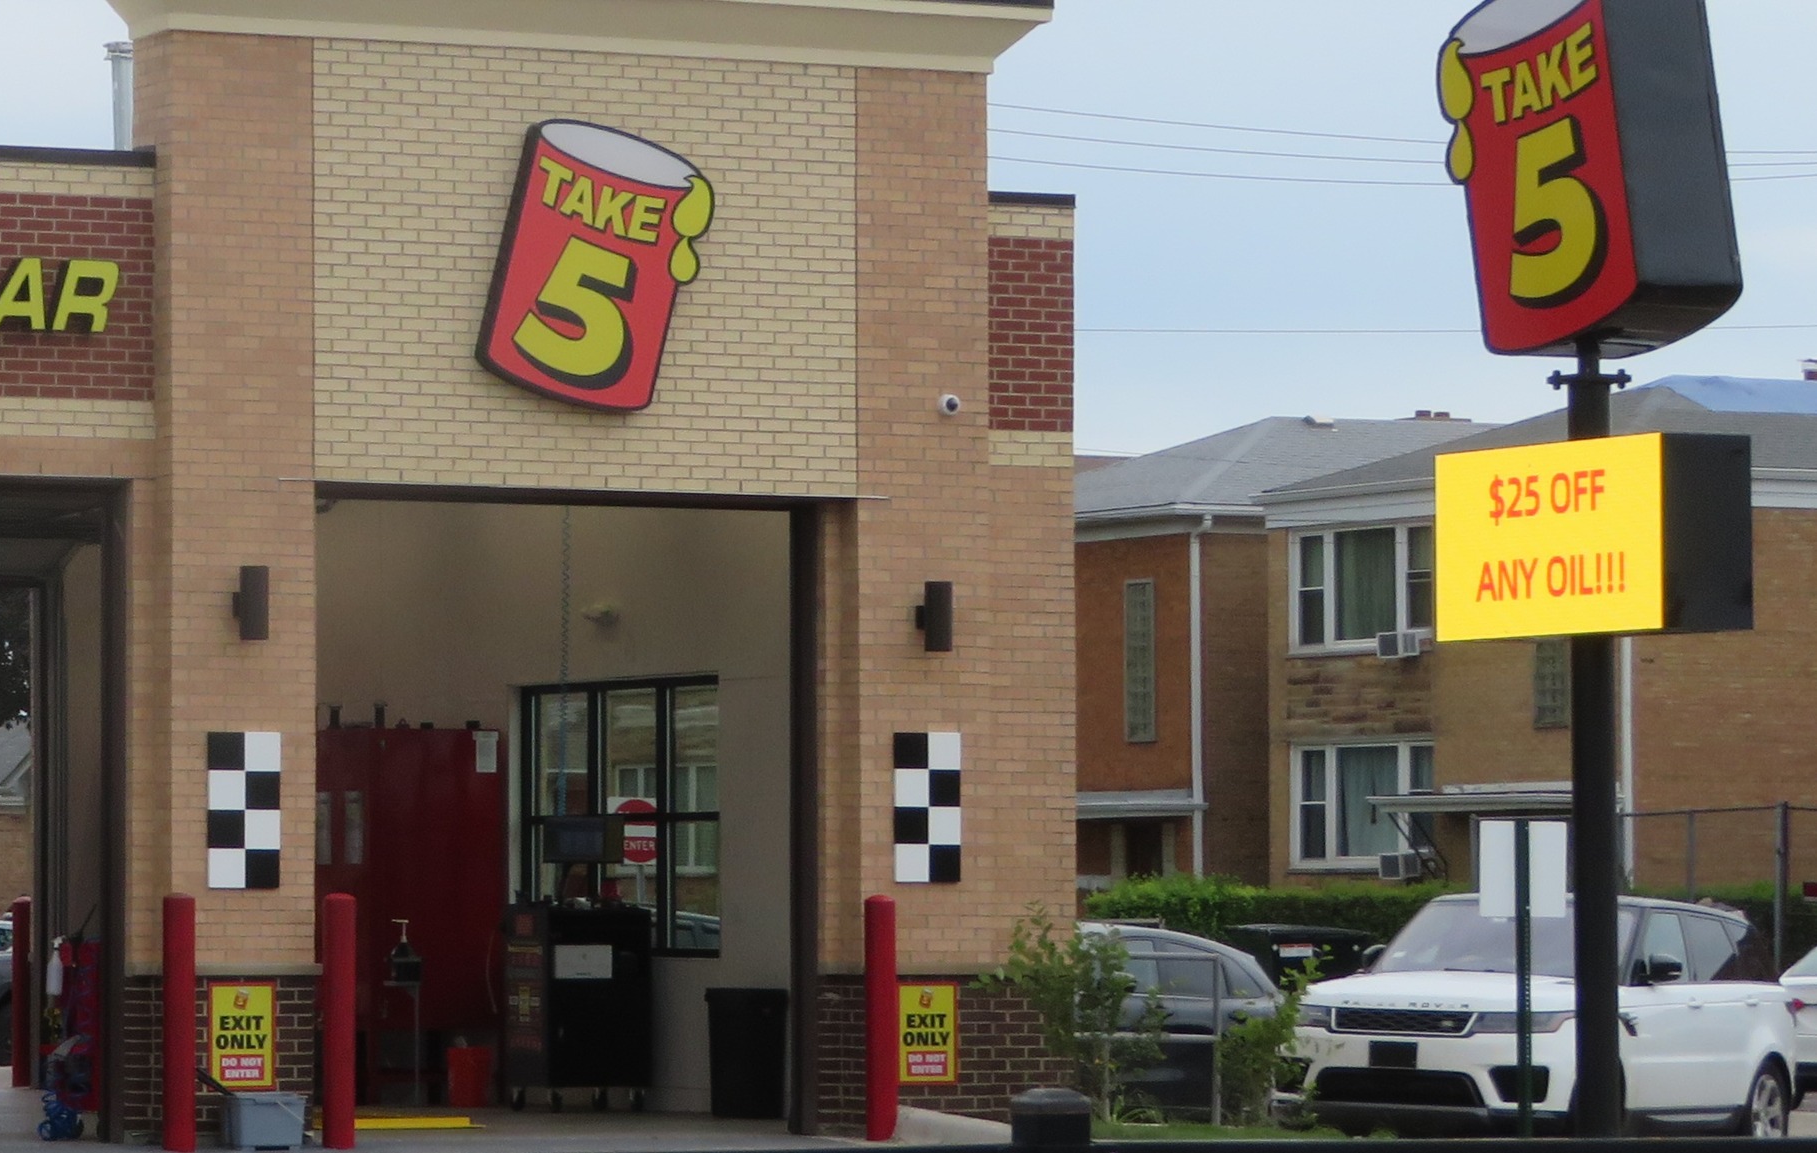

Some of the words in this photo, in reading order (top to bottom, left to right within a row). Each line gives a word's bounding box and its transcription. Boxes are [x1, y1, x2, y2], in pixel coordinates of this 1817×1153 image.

[1480, 21, 1599, 125] TAKE
[538, 155, 666, 246] TAKE
[1508, 115, 1609, 308] 5
[511, 236, 638, 390] 5
[1489, 474, 1541, 526] $25
[1550, 469, 1606, 514] OFF
[1475, 557, 1539, 602] ANY
[1546, 551, 1626, 598] OIL!!!
[623, 840, 656, 851] ENTER
[215, 1034, 268, 1050] ONLY
[219, 1015, 264, 1031] EXIT
[902, 1031, 951, 1047] ONLY
[906, 1013, 947, 1029] EXIT
